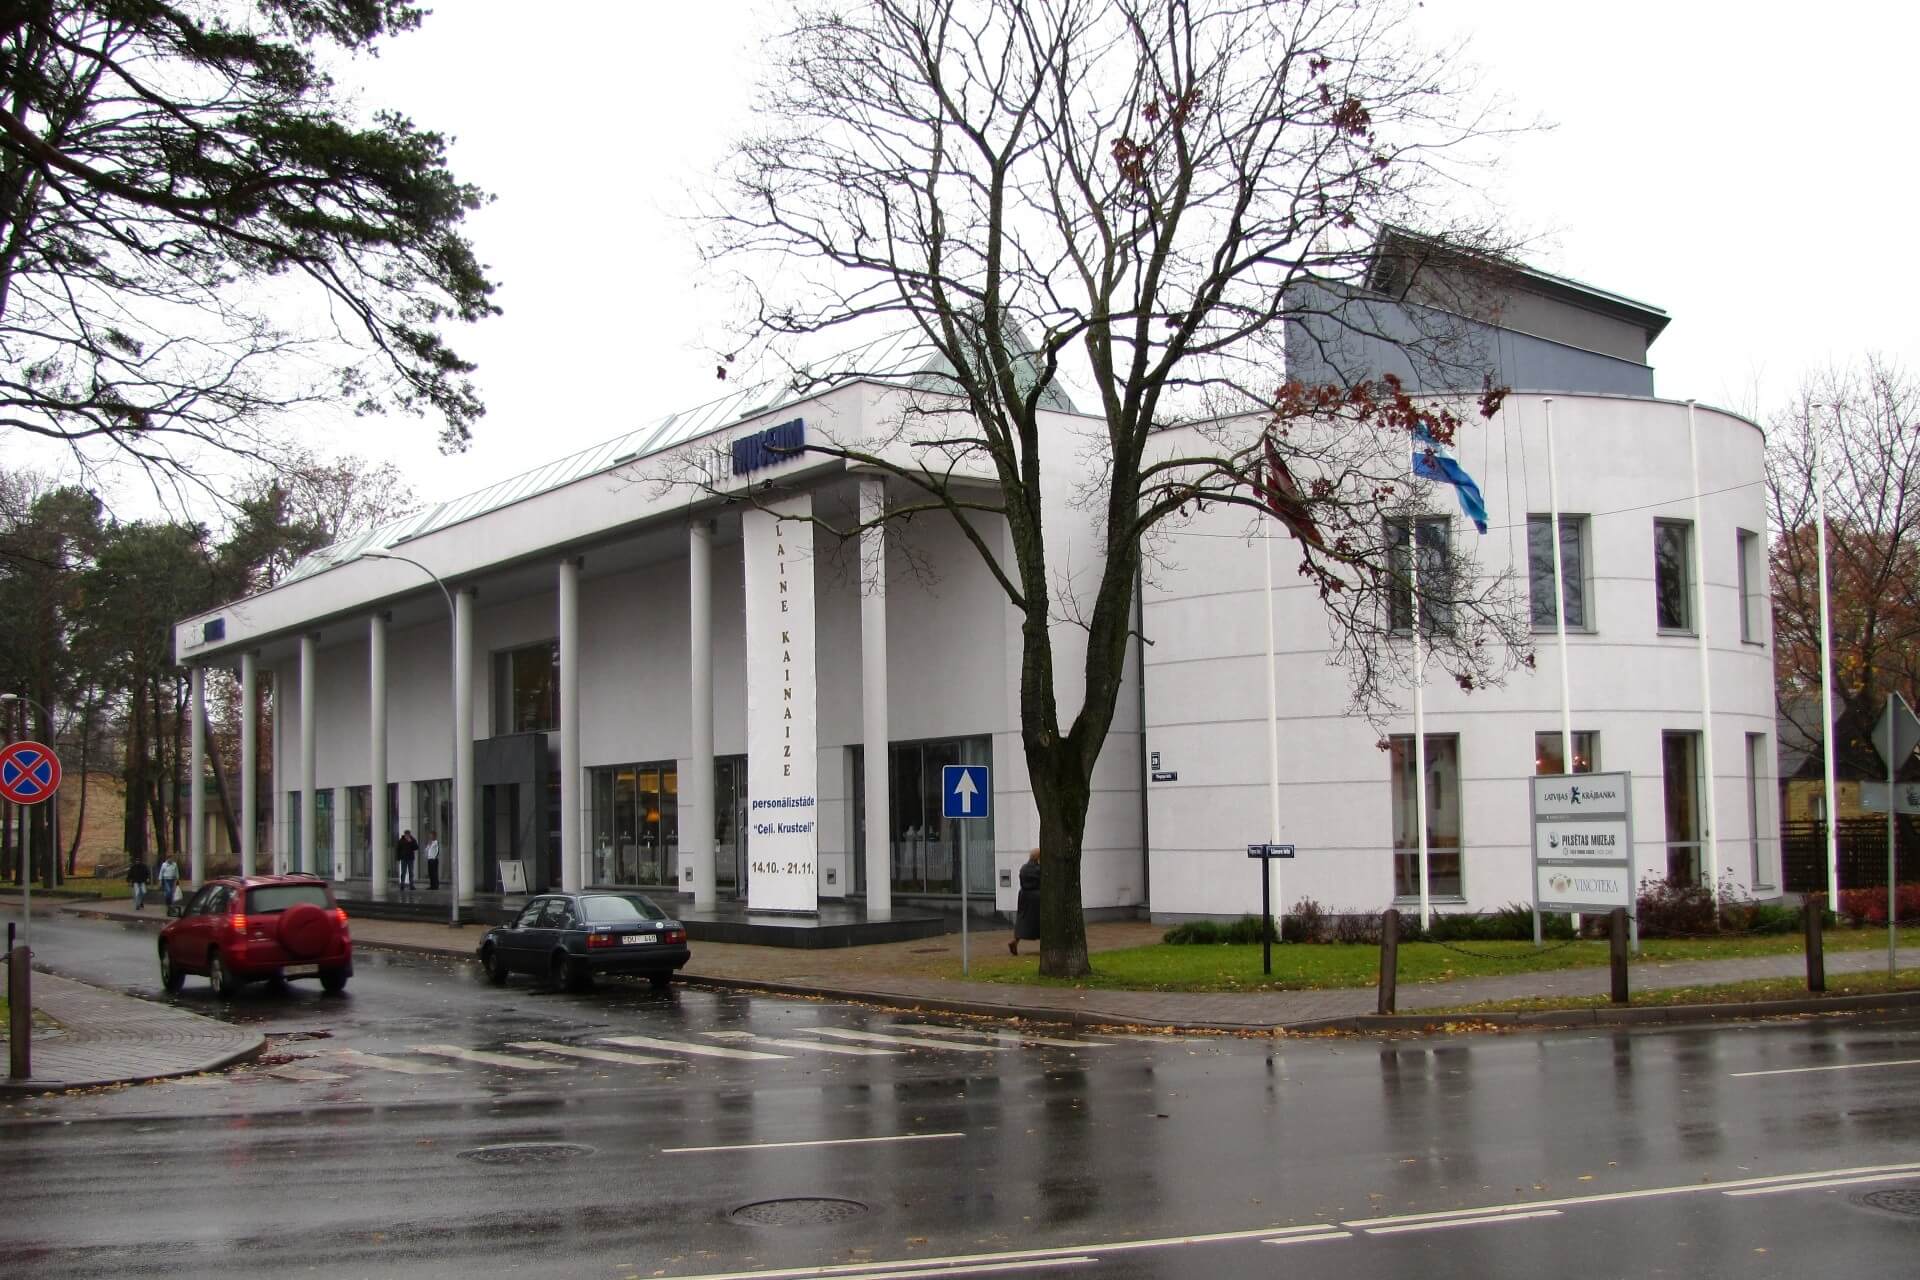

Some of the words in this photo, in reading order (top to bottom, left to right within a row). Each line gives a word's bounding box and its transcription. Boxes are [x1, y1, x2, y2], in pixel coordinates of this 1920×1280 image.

[776, 524, 788, 613] LAINE
[782, 631, 792, 777] KAINAIZE
[1544, 793, 1568, 802] LATVIJAS
[1590, 834, 1616, 847] MUZEJS
[752, 861, 779, 873] 14.10.
[787, 862, 814, 875] 21.11.
[1574, 878, 1618, 893] VINOTEKA
